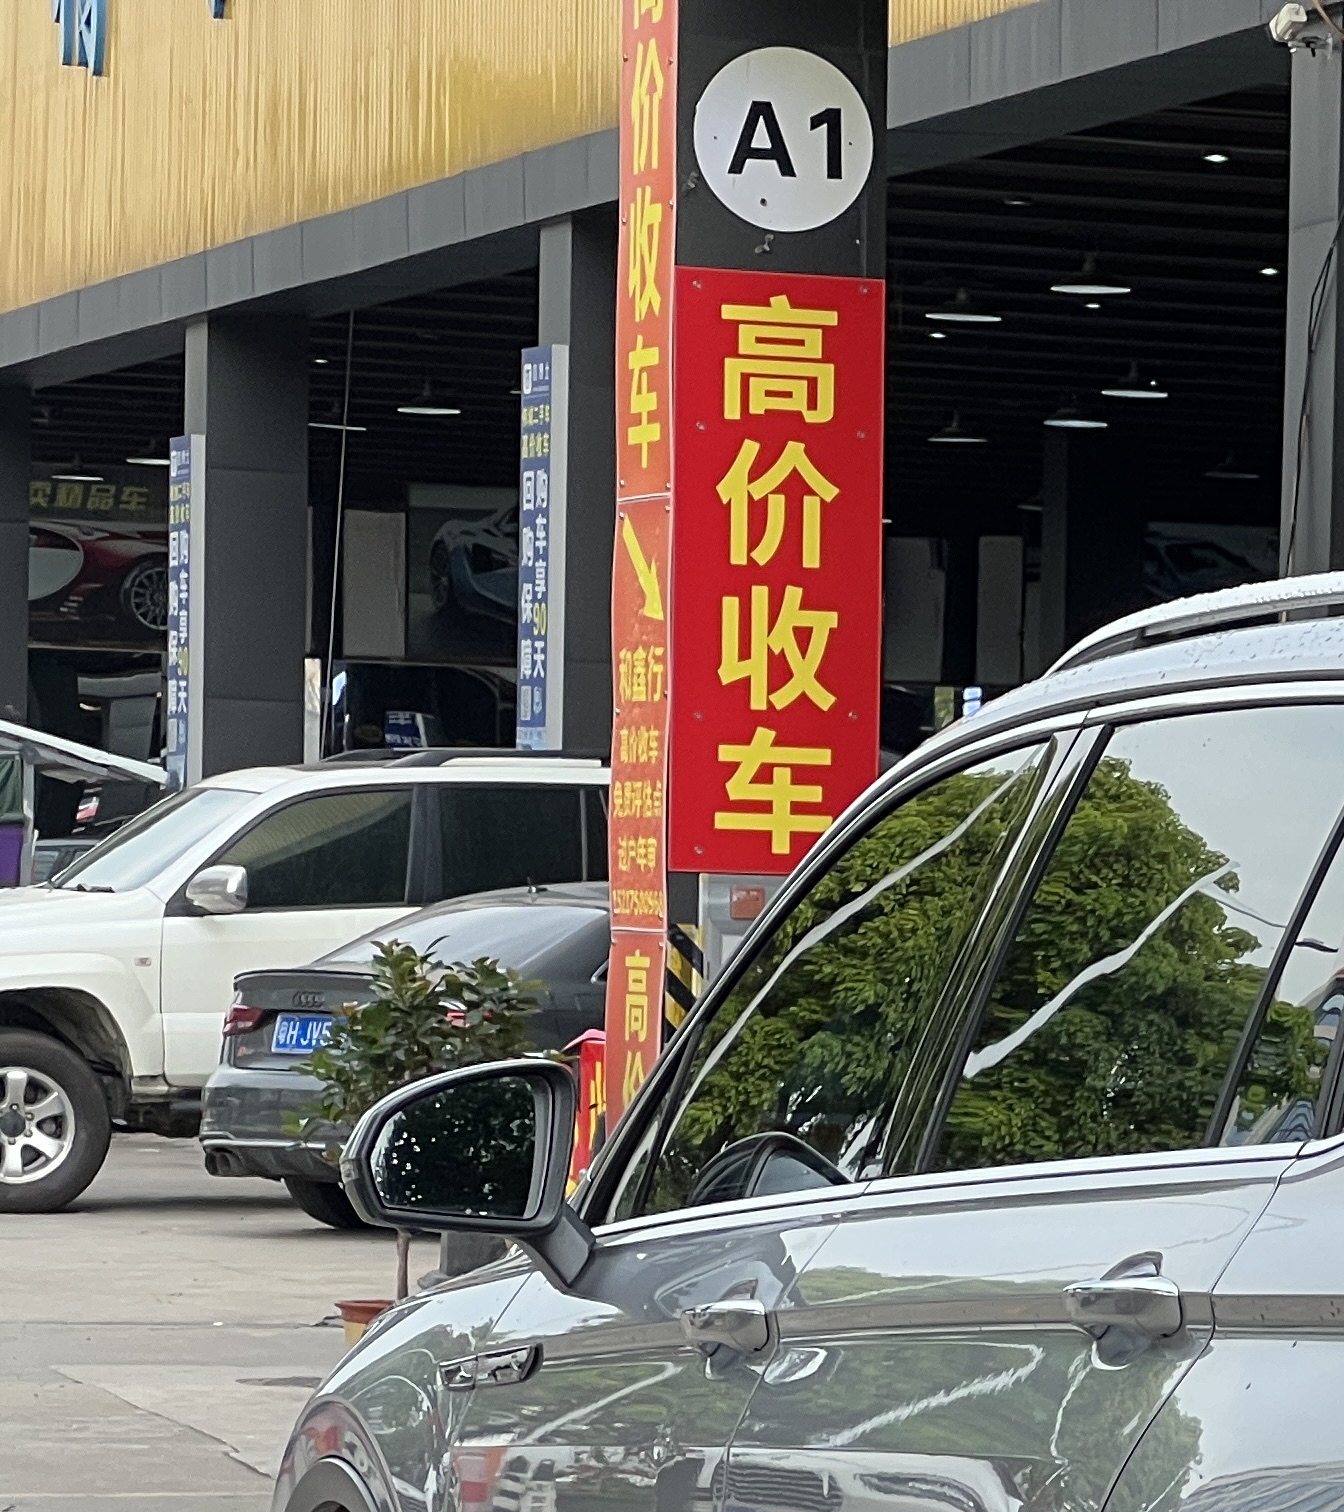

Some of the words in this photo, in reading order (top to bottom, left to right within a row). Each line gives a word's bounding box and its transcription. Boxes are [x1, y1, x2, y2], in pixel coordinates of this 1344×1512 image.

[628, 0, 665, 469] 价收车
[727, 100, 843, 181] A1
[713, 294, 841, 856] 高价收车
